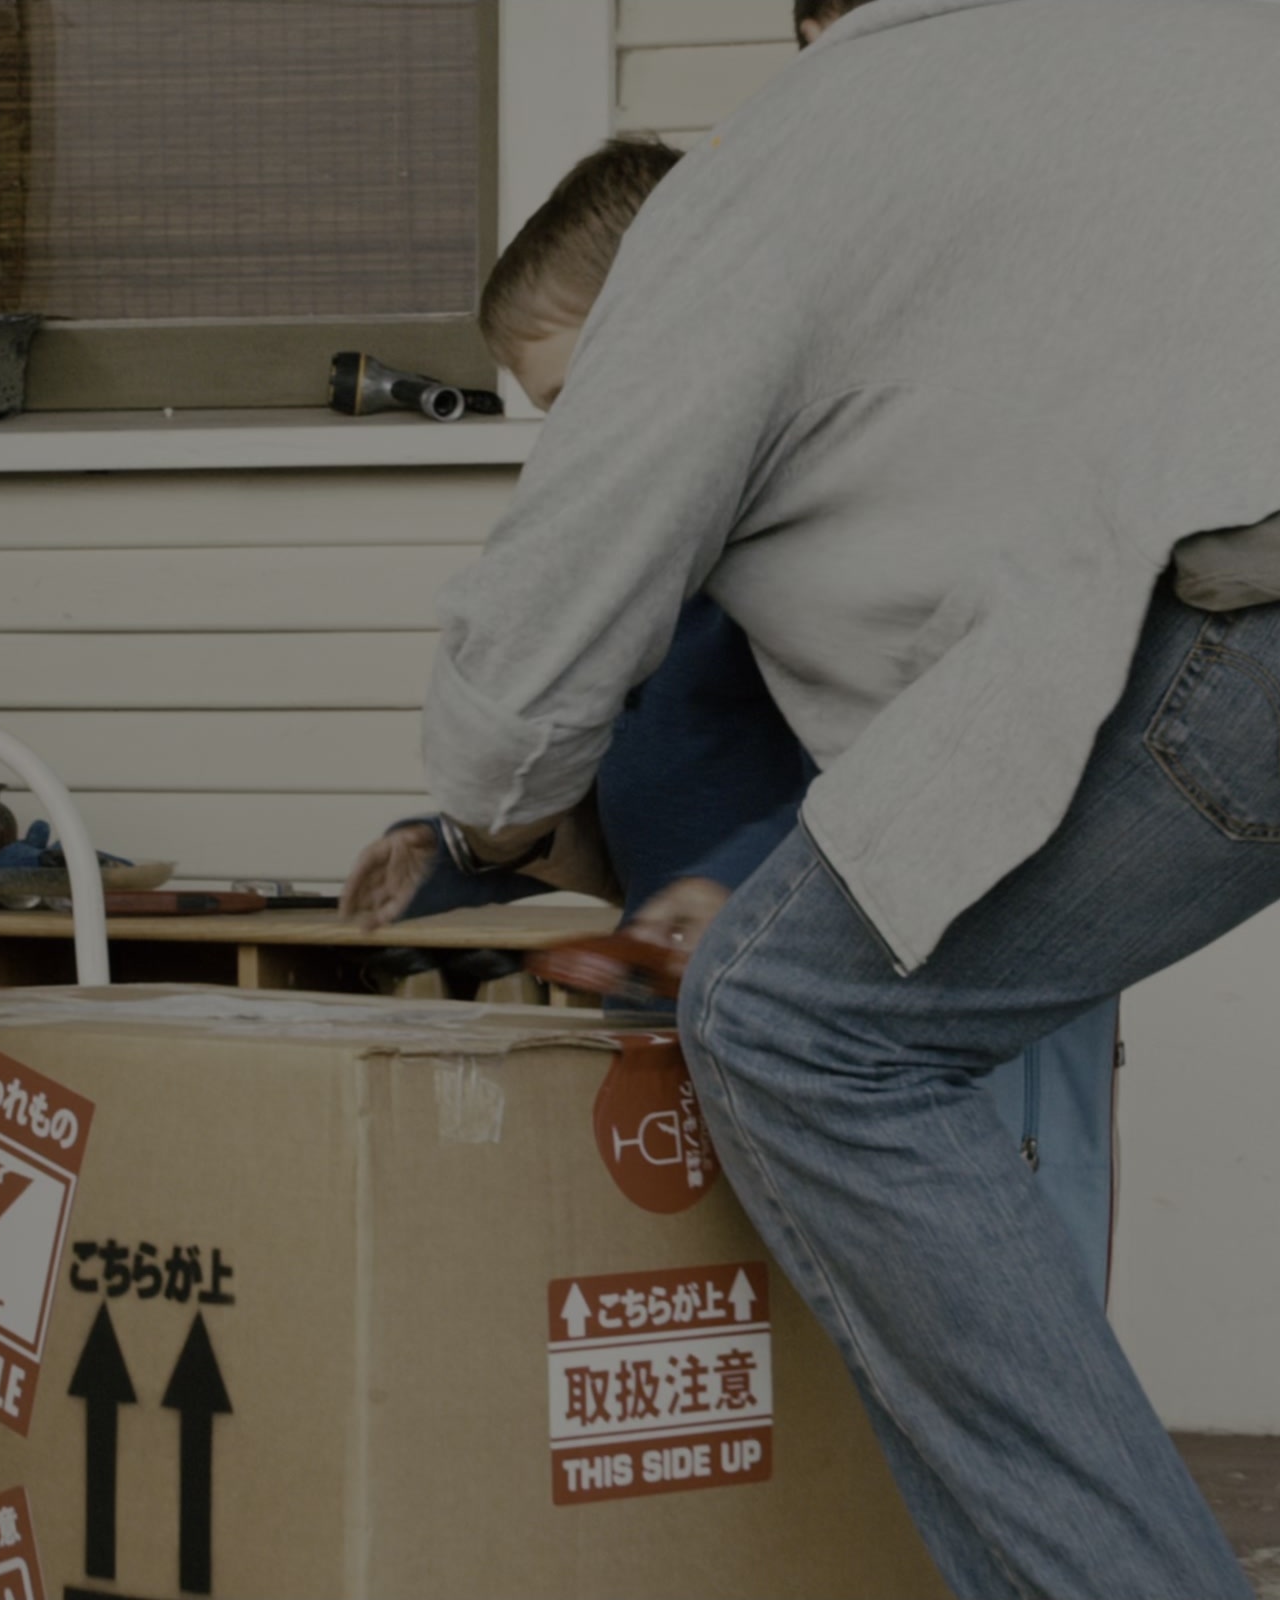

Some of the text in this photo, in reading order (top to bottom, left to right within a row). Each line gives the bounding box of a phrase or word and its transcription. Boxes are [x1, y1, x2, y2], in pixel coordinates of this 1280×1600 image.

[70, 1239, 235, 1305] こちらが上
[598, 1281, 727, 1328] こちらが上
[564, 1348, 757, 1427] 取扱注意
[562, 1439, 762, 1492] THIS SIDE UP
